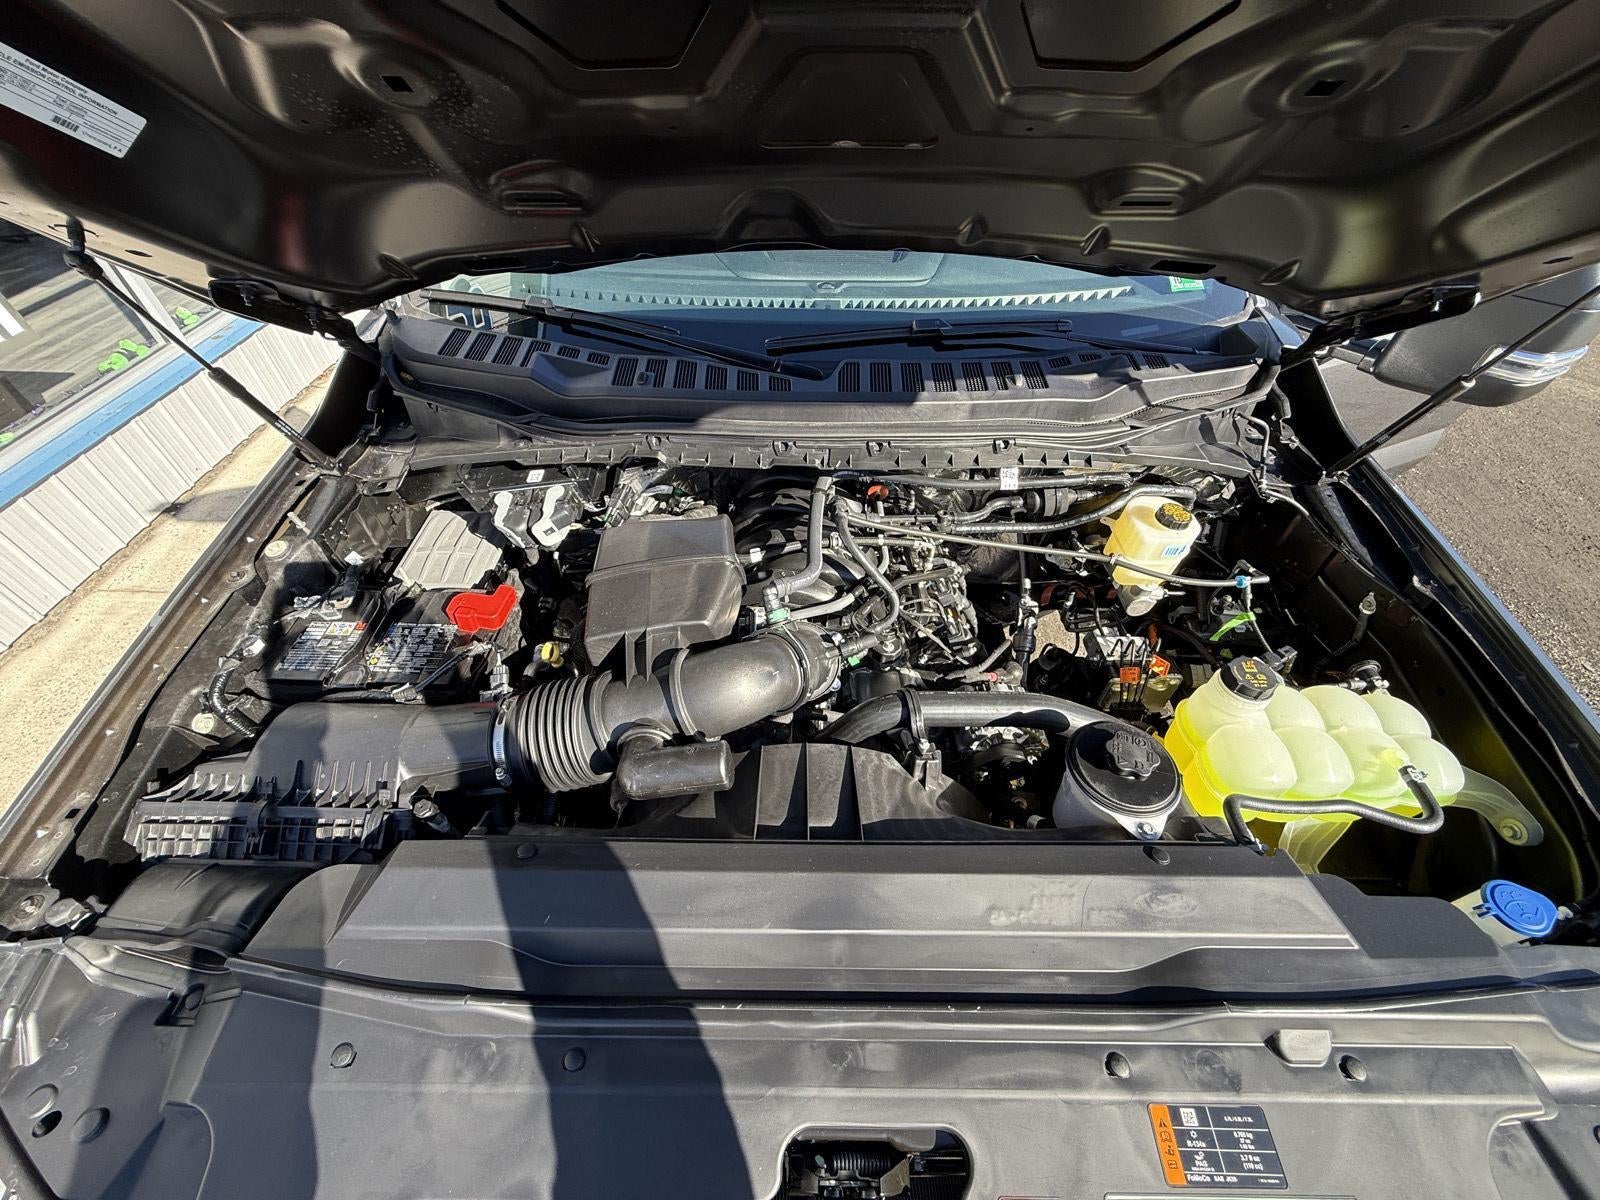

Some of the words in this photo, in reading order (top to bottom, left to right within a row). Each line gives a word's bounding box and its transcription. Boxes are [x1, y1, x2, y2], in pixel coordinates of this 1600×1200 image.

[12, 58, 47, 79] EMISSION
[46, 75, 77, 96] CONTROL
[77, 92, 119, 115] INFORMATION
[24, 58, 41, 70] Ford
[41, 66, 60, 80] Motor
[60, 77, 89, 94] Company
[1187, 1174, 1211, 1182] FoMoCo
